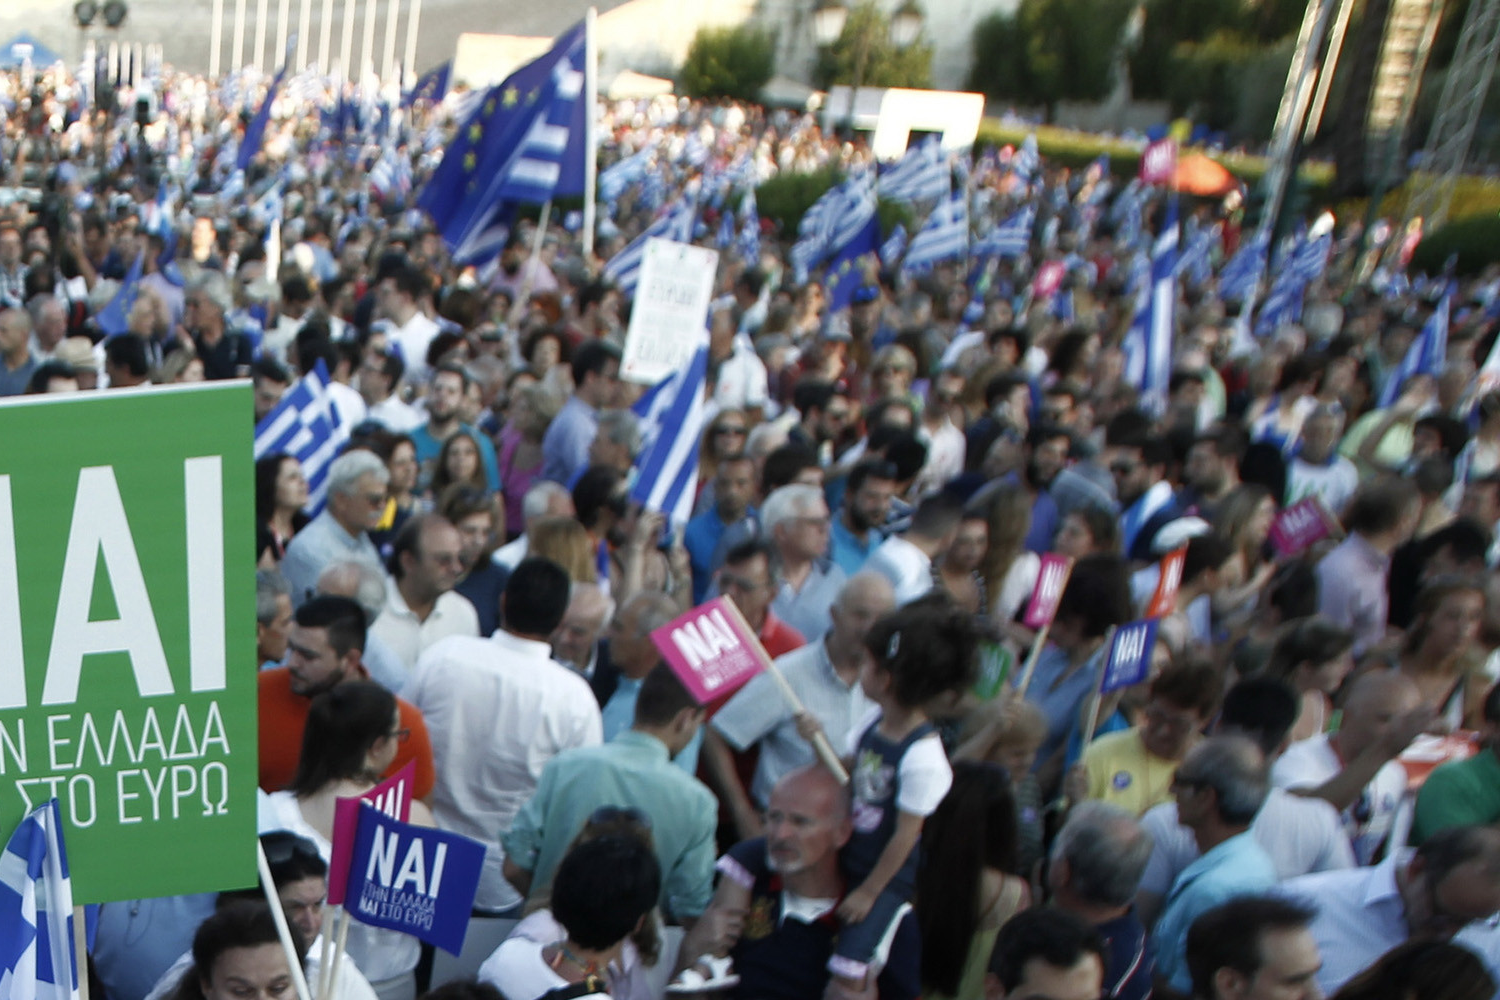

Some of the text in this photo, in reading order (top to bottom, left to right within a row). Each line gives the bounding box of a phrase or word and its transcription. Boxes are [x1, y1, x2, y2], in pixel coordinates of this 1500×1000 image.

[671, 608, 740, 671] ΝΑΙ
[1115, 624, 1147, 666] ΝΑΙ
[47, 700, 230, 771] ΕΛΛΑΔΑ
[116, 761, 229, 824] ΕΥΡΩ
[366, 824, 448, 900] ΝΑΙ
[358, 894, 379, 917] ΝΑΙ
